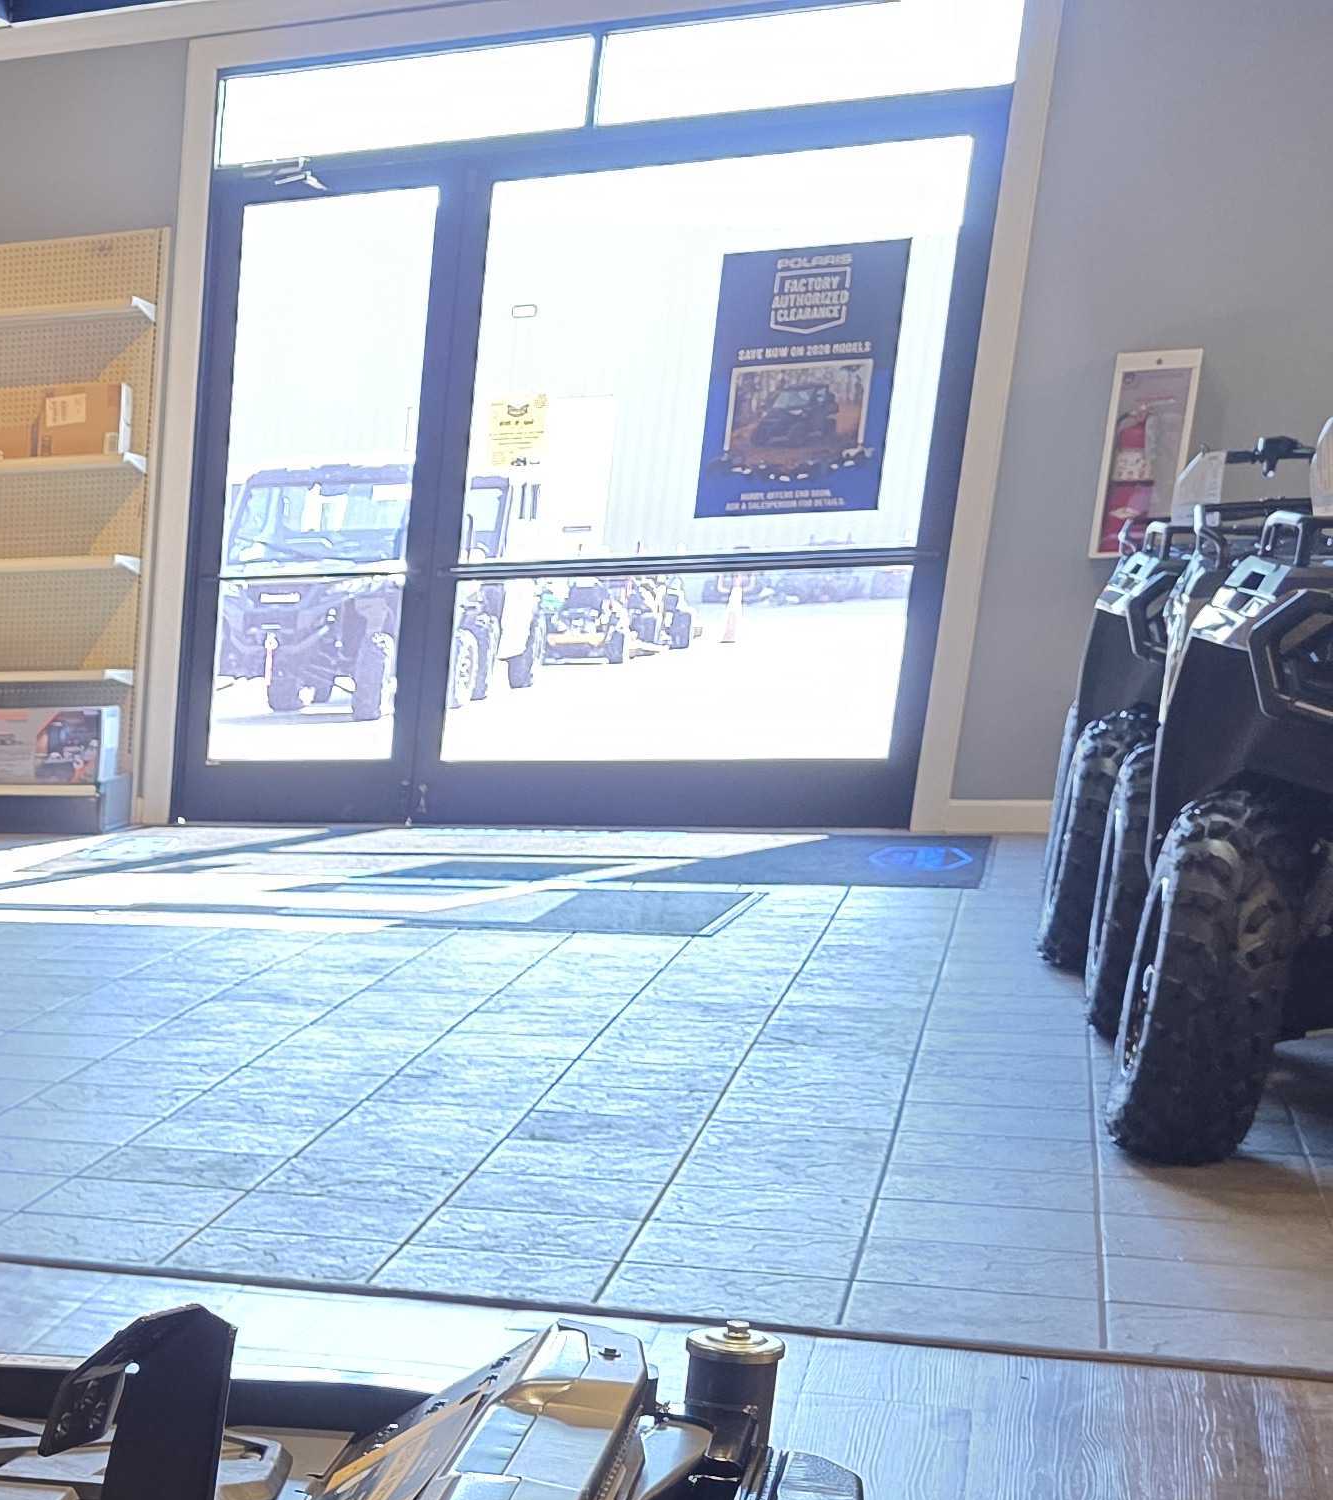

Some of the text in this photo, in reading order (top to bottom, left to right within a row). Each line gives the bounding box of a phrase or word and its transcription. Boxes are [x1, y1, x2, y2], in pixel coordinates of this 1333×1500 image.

[777, 253, 853, 270] POLARIS
[784, 275, 841, 294] FACTORY
[771, 290, 850, 309] AUTHORIZED
[776, 305, 841, 323] CLEARANCE
